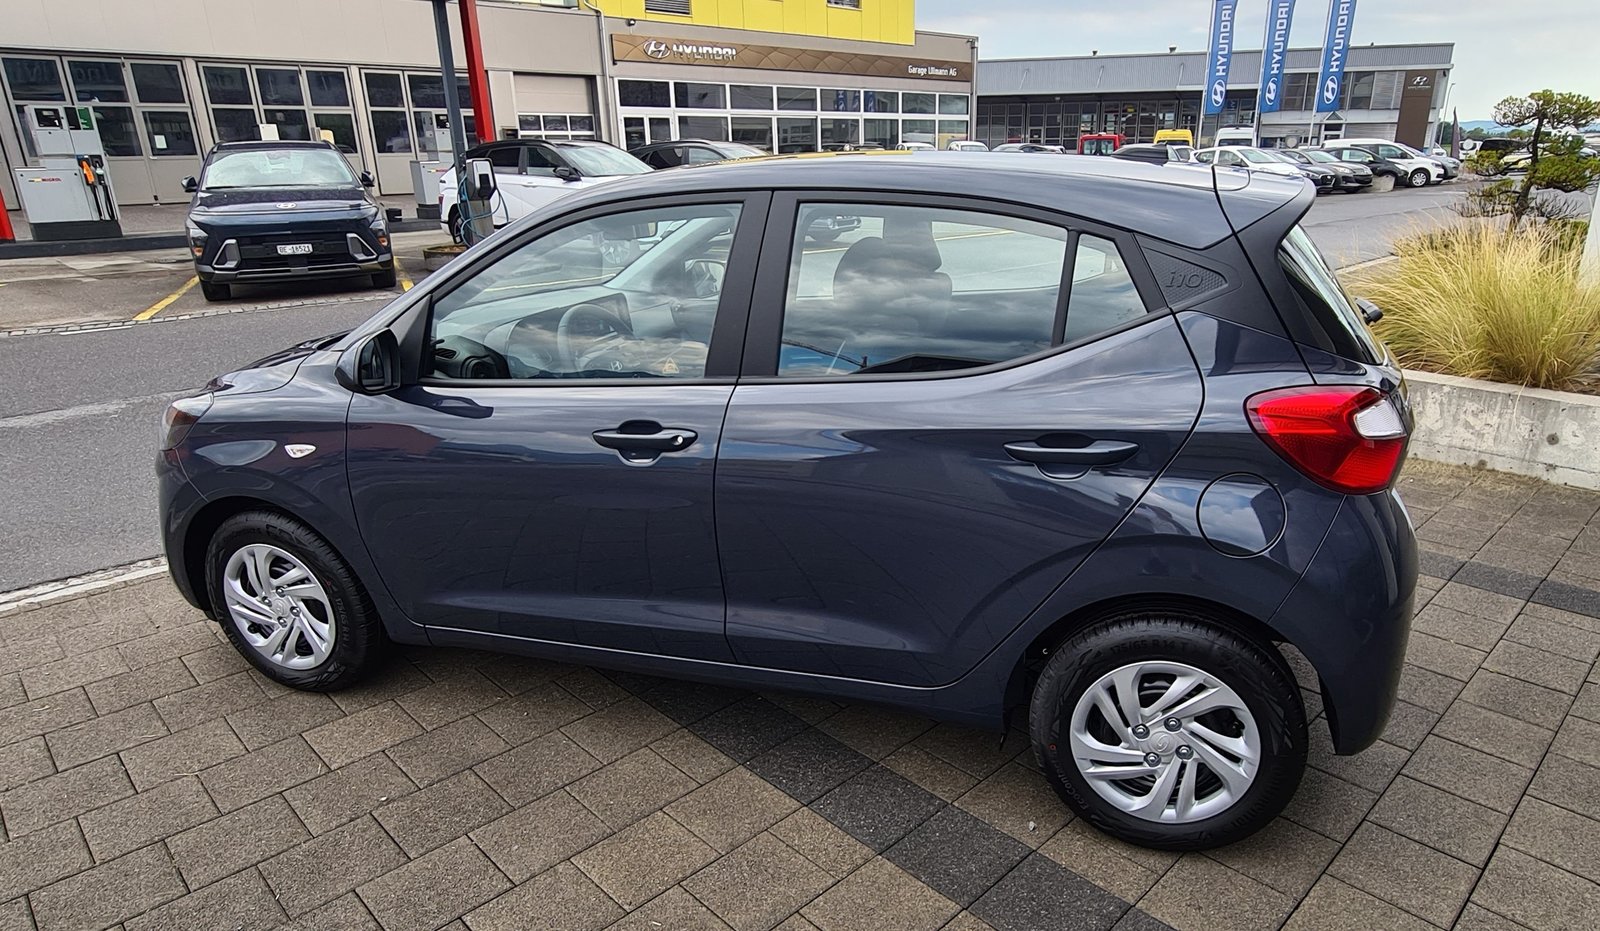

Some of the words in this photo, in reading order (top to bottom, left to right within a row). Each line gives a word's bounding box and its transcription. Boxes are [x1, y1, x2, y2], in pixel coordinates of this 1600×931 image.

[672, 44, 737, 60] HYUNDAI
[908, 65, 927, 77] Garage
[949, 67, 958, 77] AG
[1216, 4, 1232, 76] HYUNDAI
[1271, 2, 1289, 75] HYUNDAI
[1329, 0, 1350, 72] HYUNDAI
